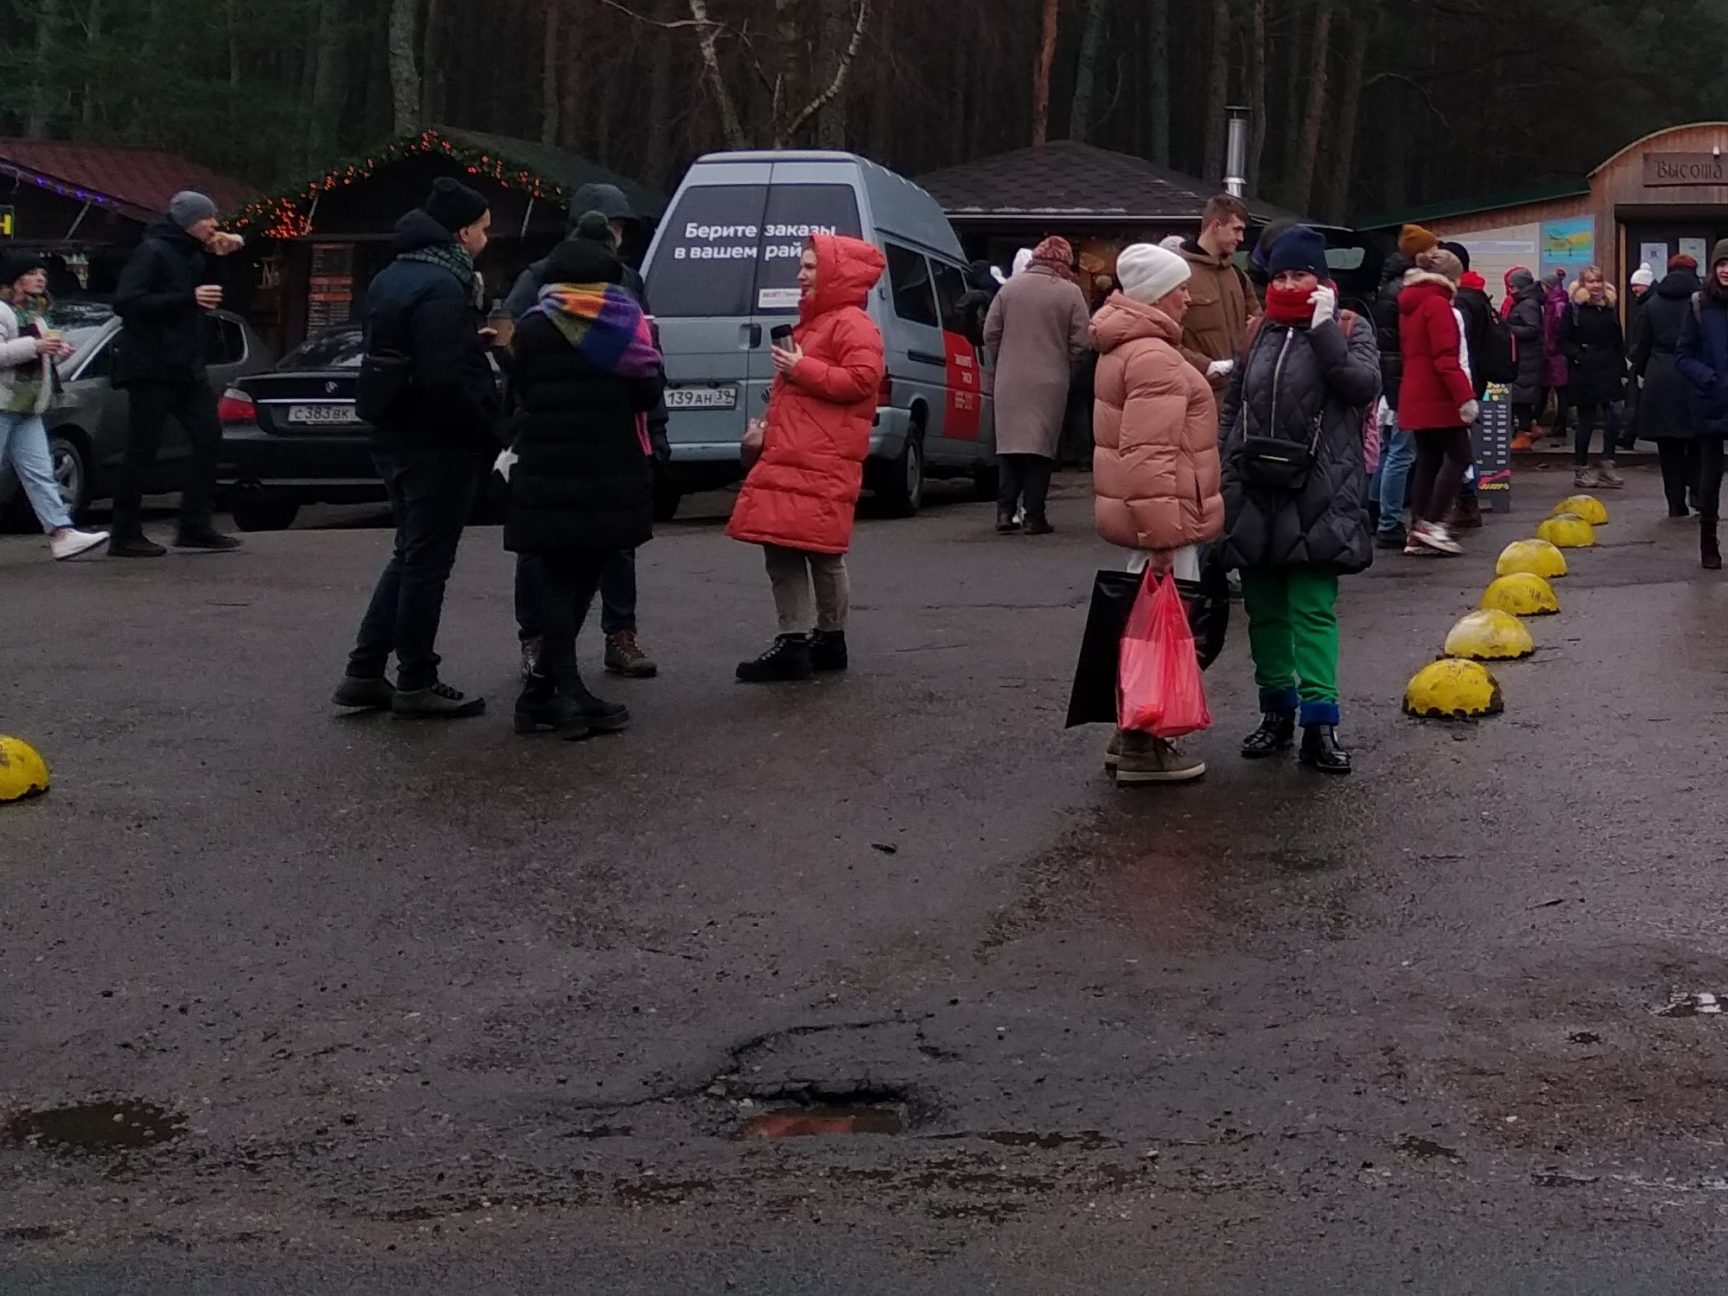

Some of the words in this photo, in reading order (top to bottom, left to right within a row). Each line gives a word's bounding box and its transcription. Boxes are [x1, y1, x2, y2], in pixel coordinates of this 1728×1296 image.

[685, 222, 757, 241] Берите
[764, 224, 836, 237] заказы
[674, 247, 686, 259] в
[690, 246, 757, 259] вашем
[765, 242, 803, 261] рай
[667, 391, 712, 405] 139АН
